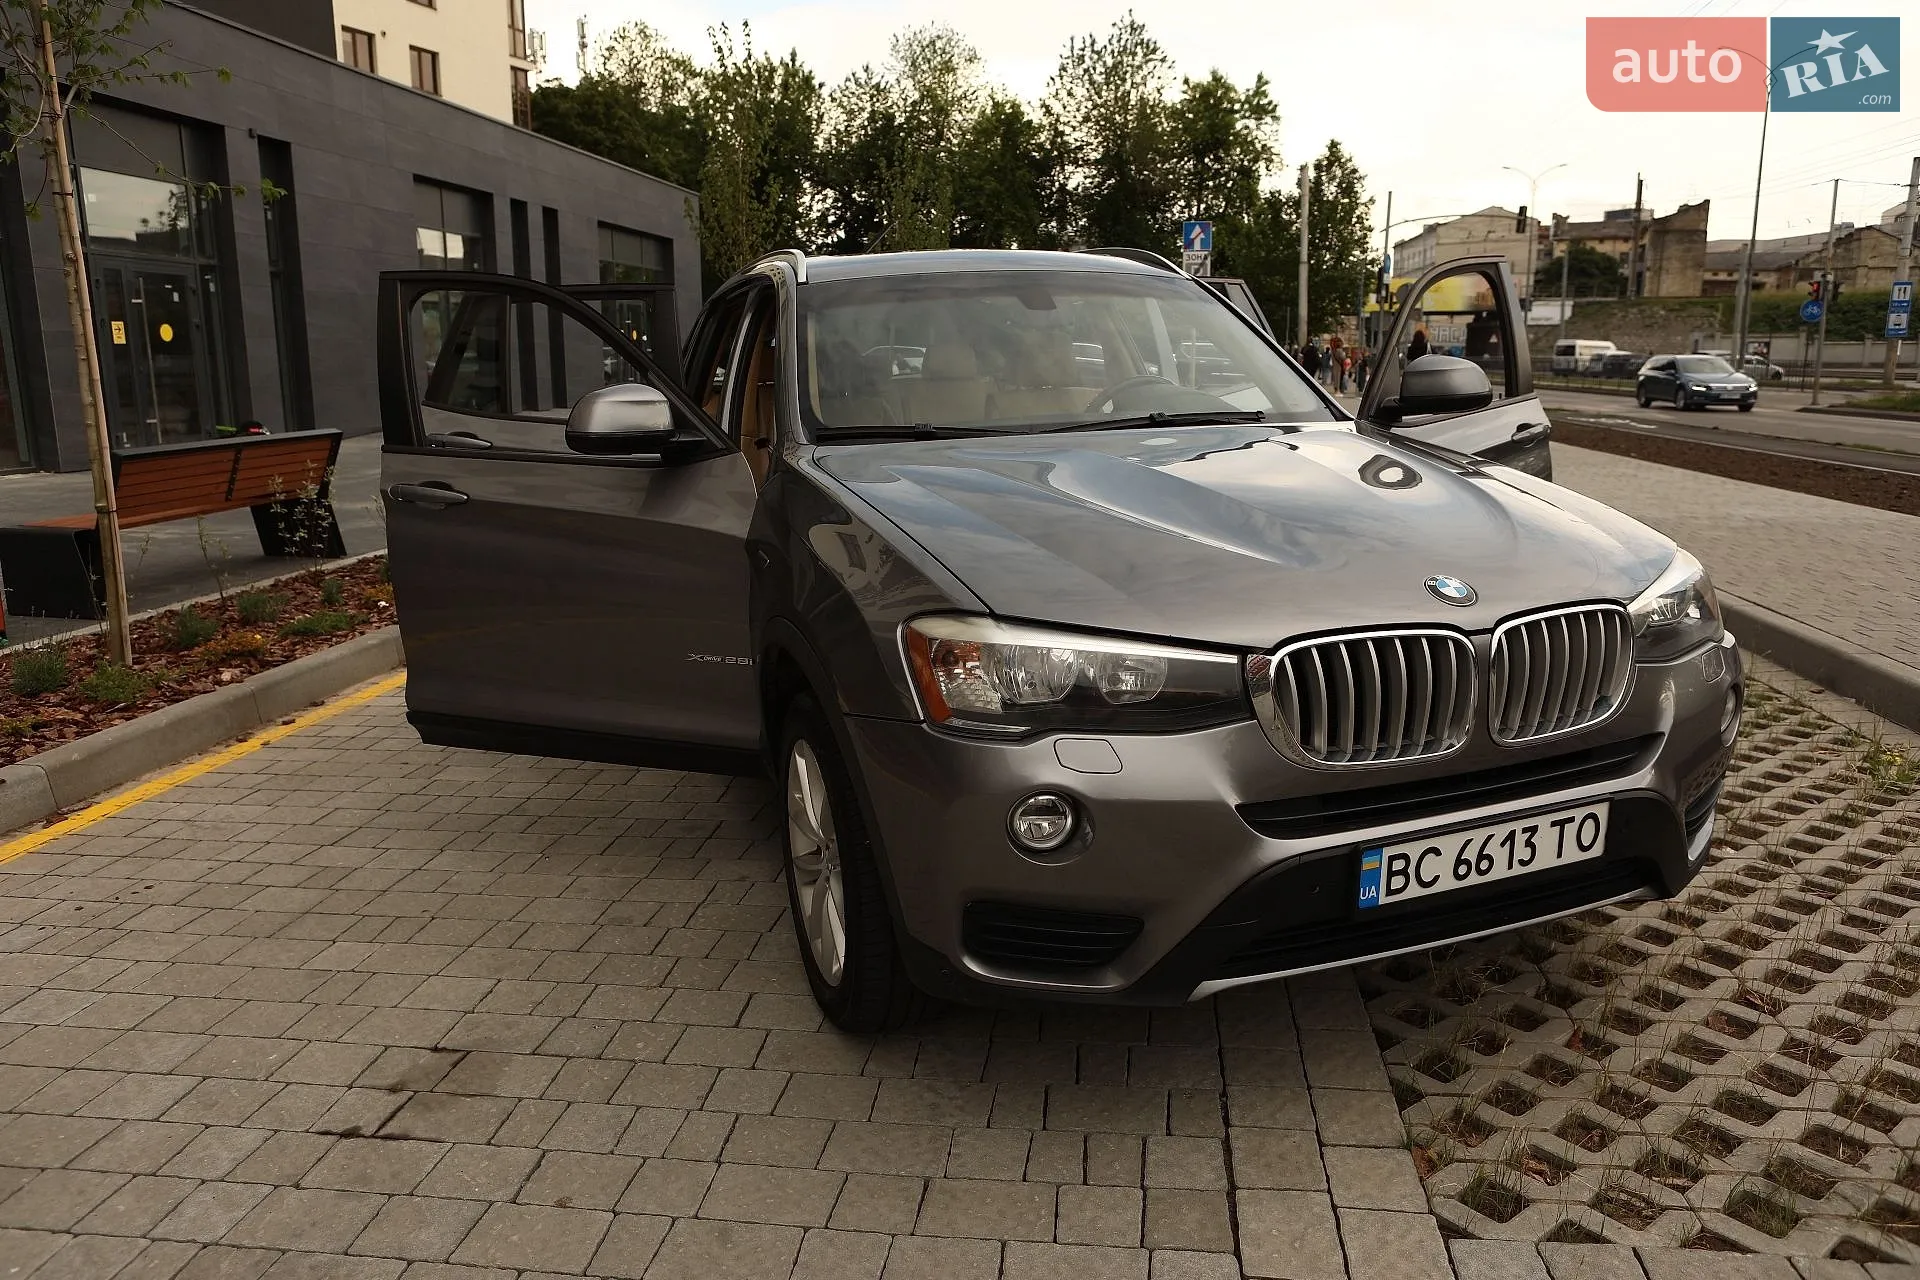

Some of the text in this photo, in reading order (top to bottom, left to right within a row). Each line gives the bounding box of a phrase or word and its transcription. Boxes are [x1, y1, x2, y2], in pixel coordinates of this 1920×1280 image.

[1185, 253, 1208, 261] ЗОНА
[1385, 812, 1601, 897] BC 6613 TO
[1360, 885, 1377, 899] UA
